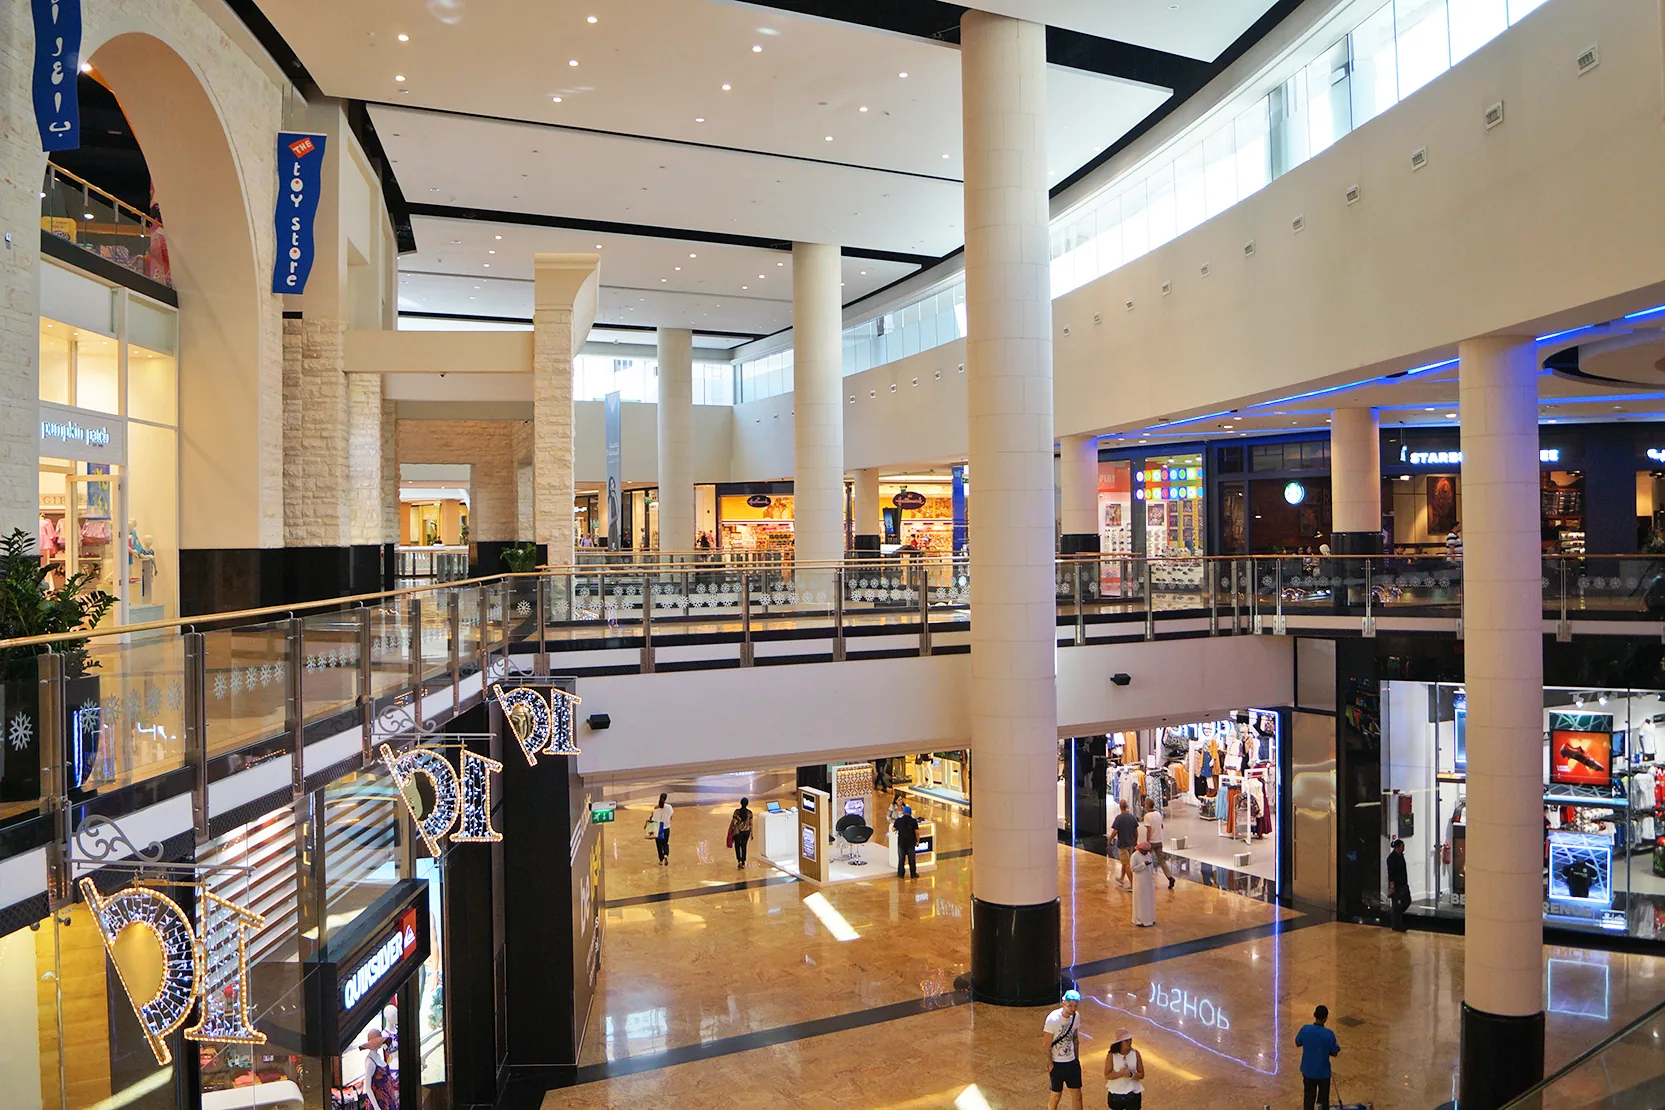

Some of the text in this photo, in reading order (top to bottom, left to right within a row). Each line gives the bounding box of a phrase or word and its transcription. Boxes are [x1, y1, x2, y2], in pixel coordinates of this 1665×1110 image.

[292, 139, 313, 154] THE
[286, 217, 301, 286] store
[40, 421, 110, 446] pumpkin patch
[344, 930, 404, 1010] QUIKSILVER
